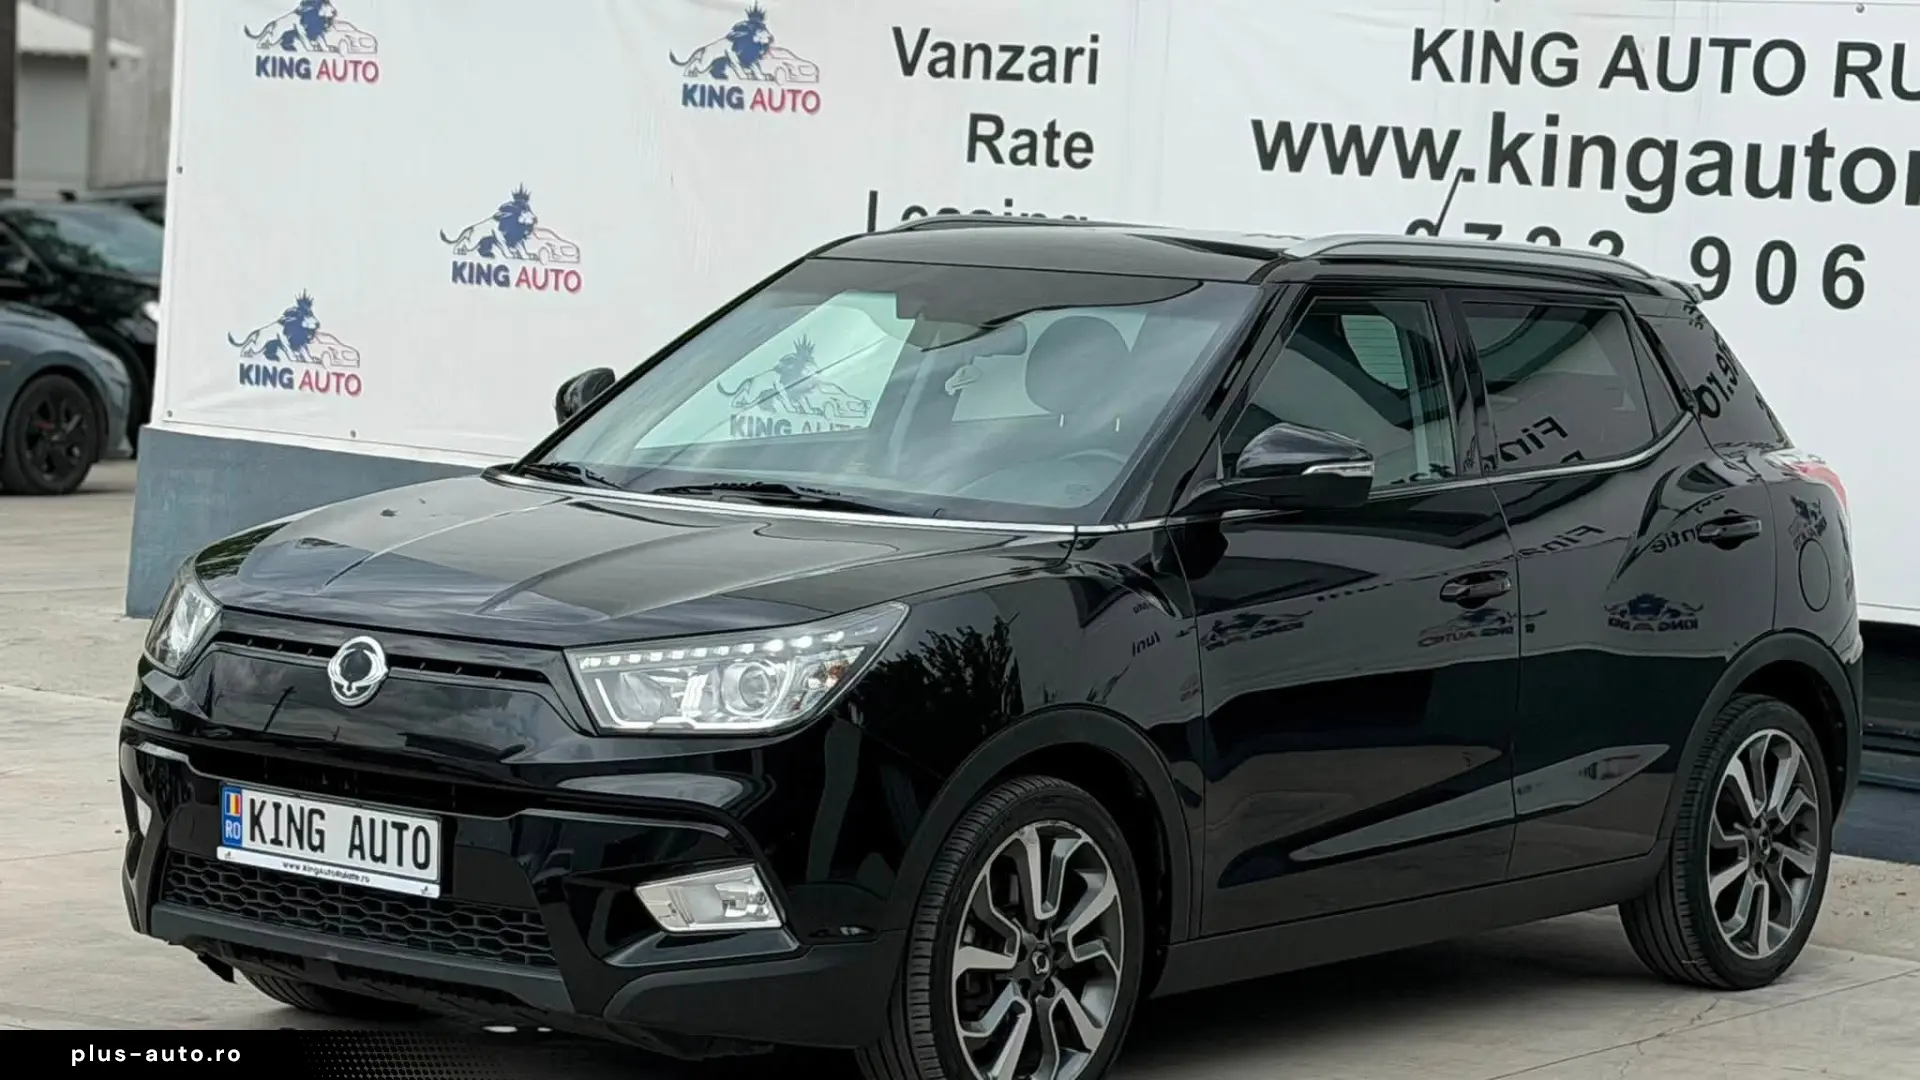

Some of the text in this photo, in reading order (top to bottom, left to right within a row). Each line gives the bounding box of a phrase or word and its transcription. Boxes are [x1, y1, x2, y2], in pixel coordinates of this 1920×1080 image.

[255, 55, 379, 83] KING AUTO
[892, 26, 1099, 85] Vanzari
[1411, 27, 1579, 88] KING
[1598, 35, 1806, 97] AUTO
[681, 83, 821, 114] KING AUTO
[967, 113, 1094, 170] Rate
[451, 260, 582, 293] KING AUTO
[1690, 236, 1866, 310] 906
[239, 363, 362, 396] KING AUTO
[730, 414, 793, 438] KING
[224, 797, 432, 871] RO KING AUTO
